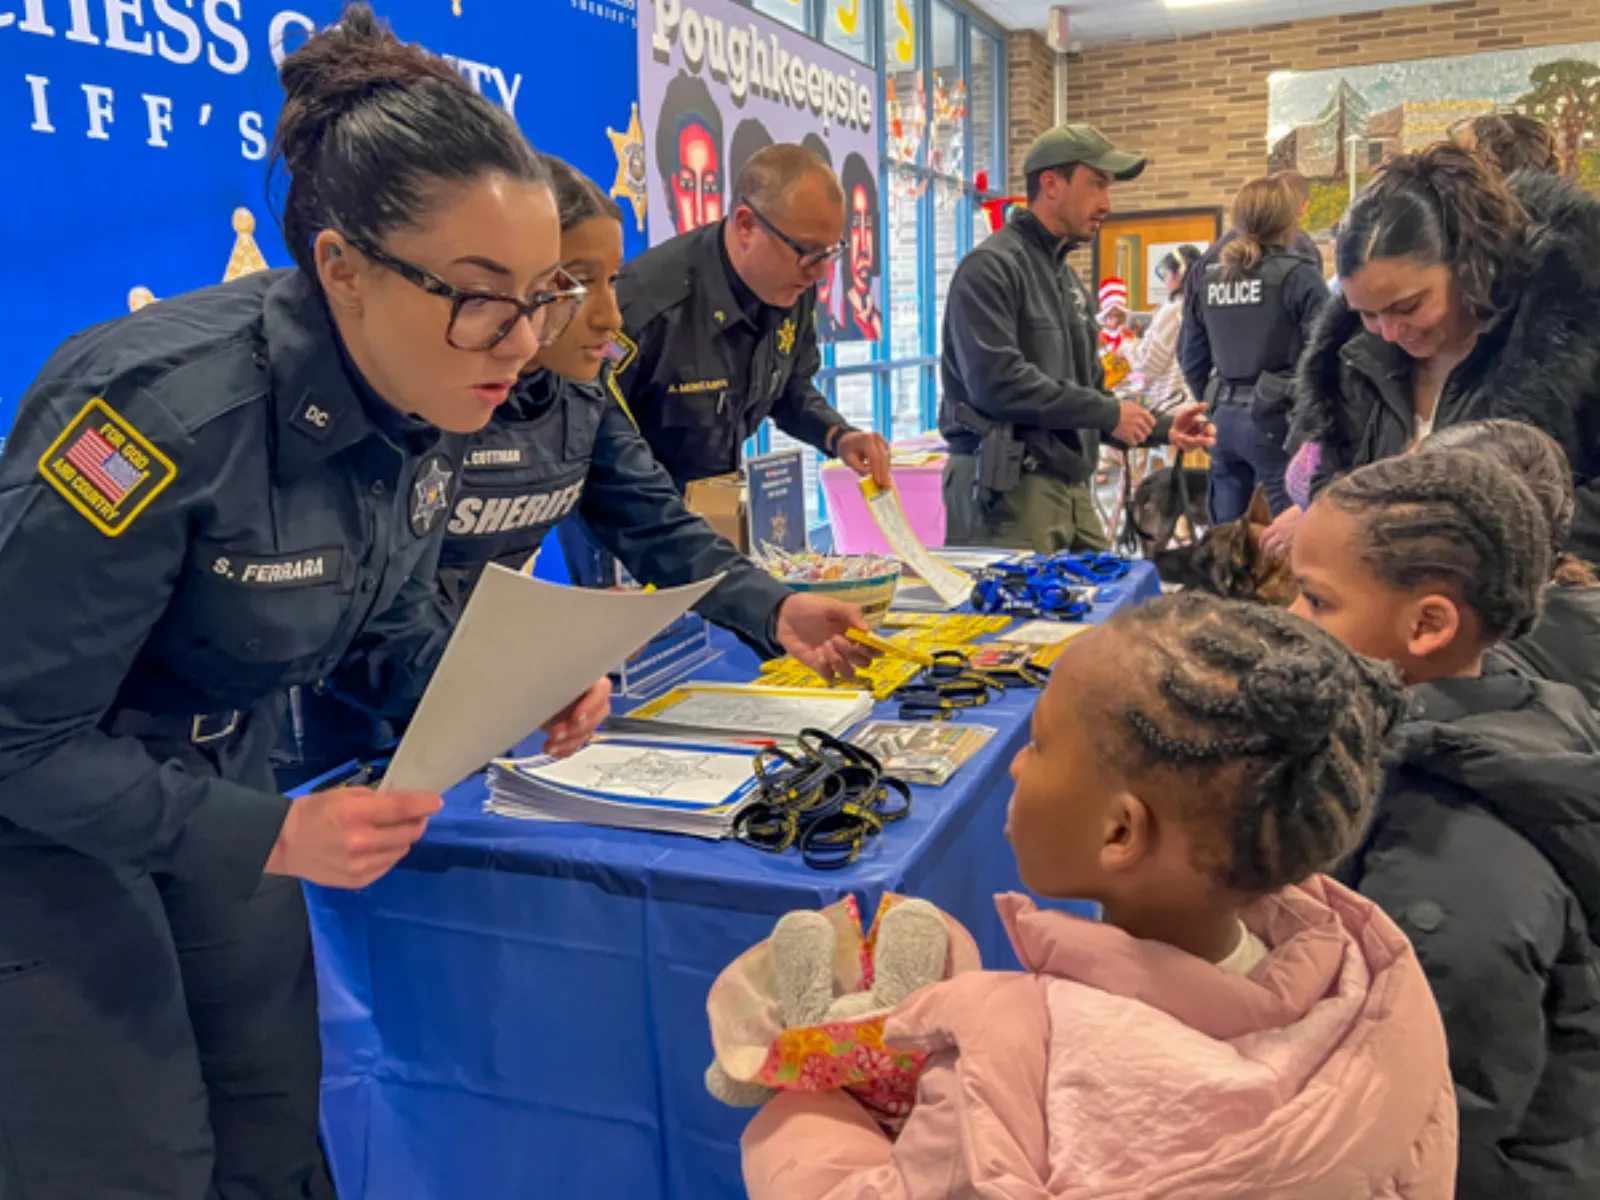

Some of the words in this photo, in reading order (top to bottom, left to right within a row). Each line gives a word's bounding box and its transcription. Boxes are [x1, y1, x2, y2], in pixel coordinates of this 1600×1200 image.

[652, 0, 873, 128] Poughkeepsie
[1207, 279, 1262, 306] POLICE
[305, 404, 329, 427] DC
[100, 422, 126, 448] FOR
[121, 442, 150, 471] GOD
[70, 475, 120, 521] COUNTRY
[447, 477, 585, 535] SHERIFF
[212, 557, 235, 579] S.
